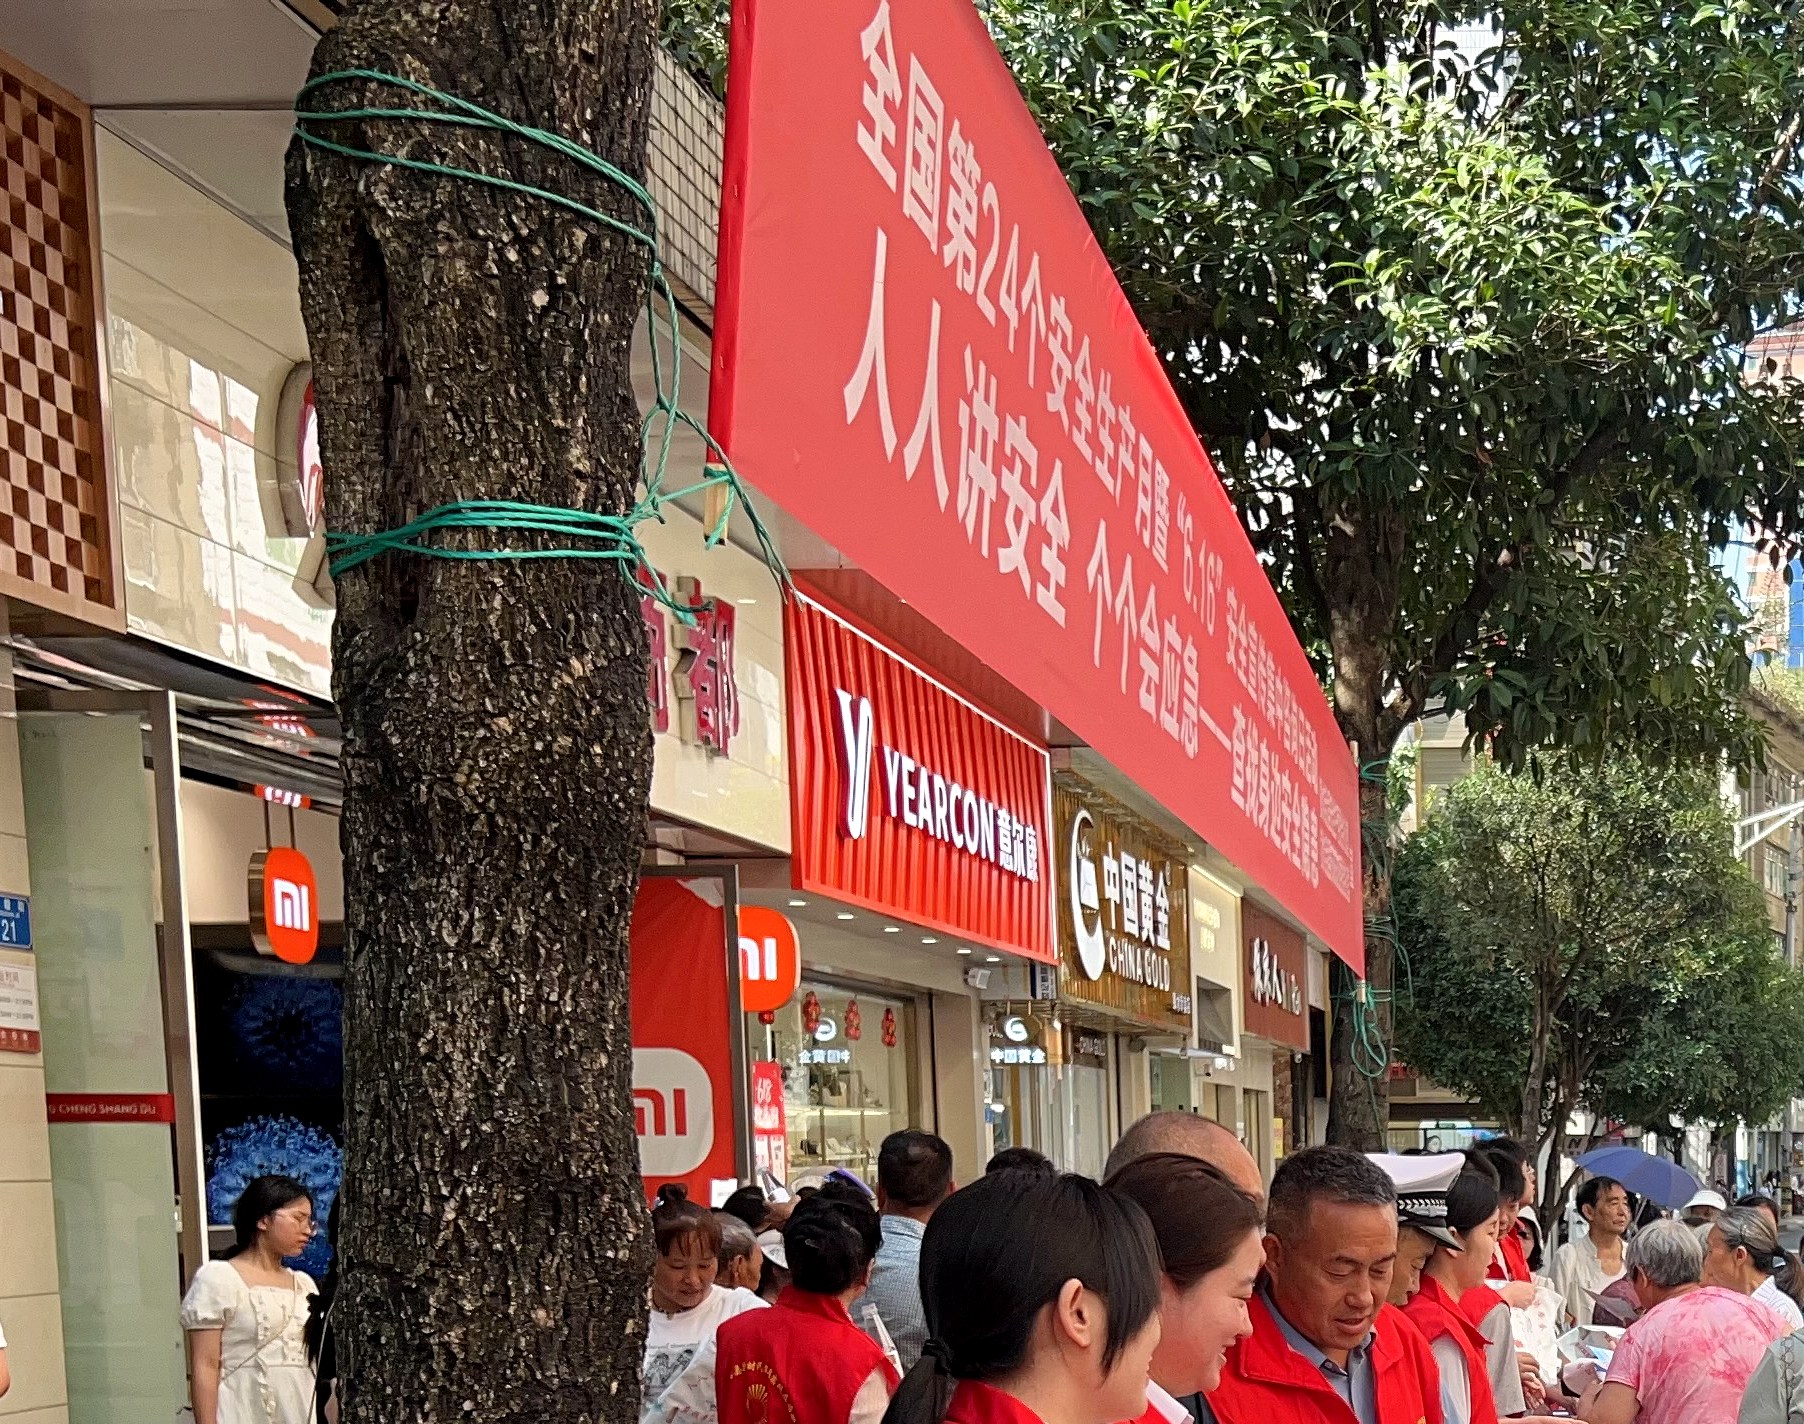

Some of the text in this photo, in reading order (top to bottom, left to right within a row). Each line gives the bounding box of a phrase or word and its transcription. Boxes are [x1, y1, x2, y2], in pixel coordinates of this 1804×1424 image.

[843, 226, 1069, 629] 人人讲安全
[883, 744, 996, 862] YEARCON
[997, 809, 1039, 883] 意尔康
[1, 919, 17, 942] 21
[1103, 841, 1171, 950] 中国黄金
[1109, 936, 1171, 991] CHINA GOLD
[990, 1048, 1046, 1064] 中国黄金
